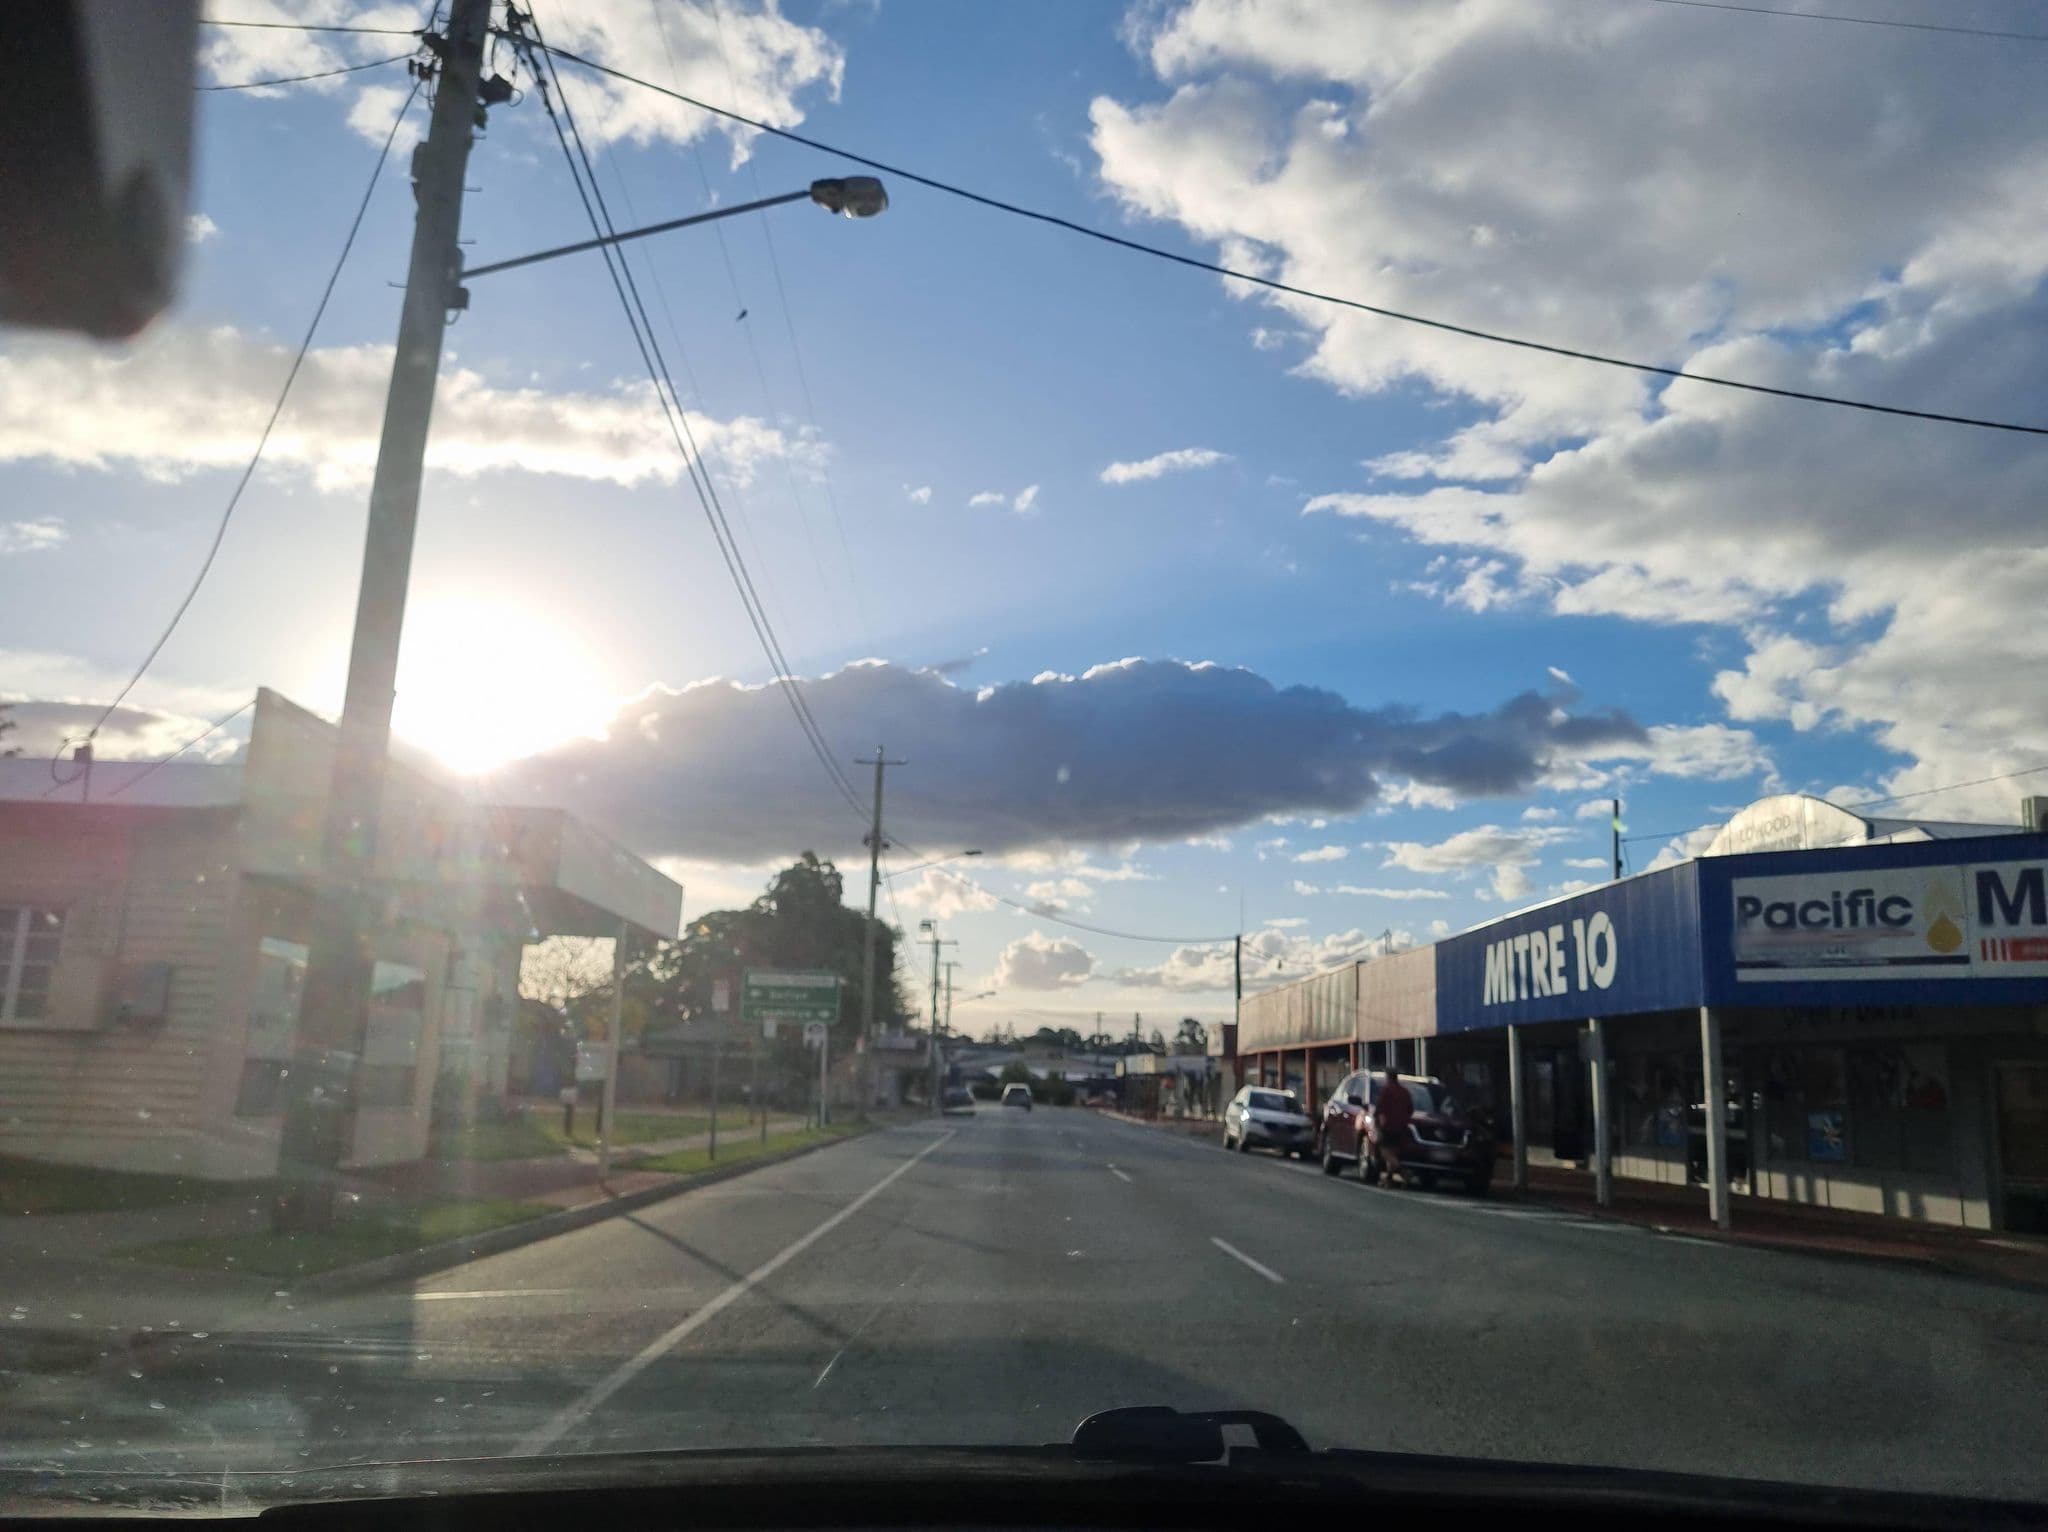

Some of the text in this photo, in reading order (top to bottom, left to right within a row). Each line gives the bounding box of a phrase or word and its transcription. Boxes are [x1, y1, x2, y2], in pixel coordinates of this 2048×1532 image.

[1736, 888, 1913, 930] Pacific
[1483, 911, 1617, 1006] MITRE 10
